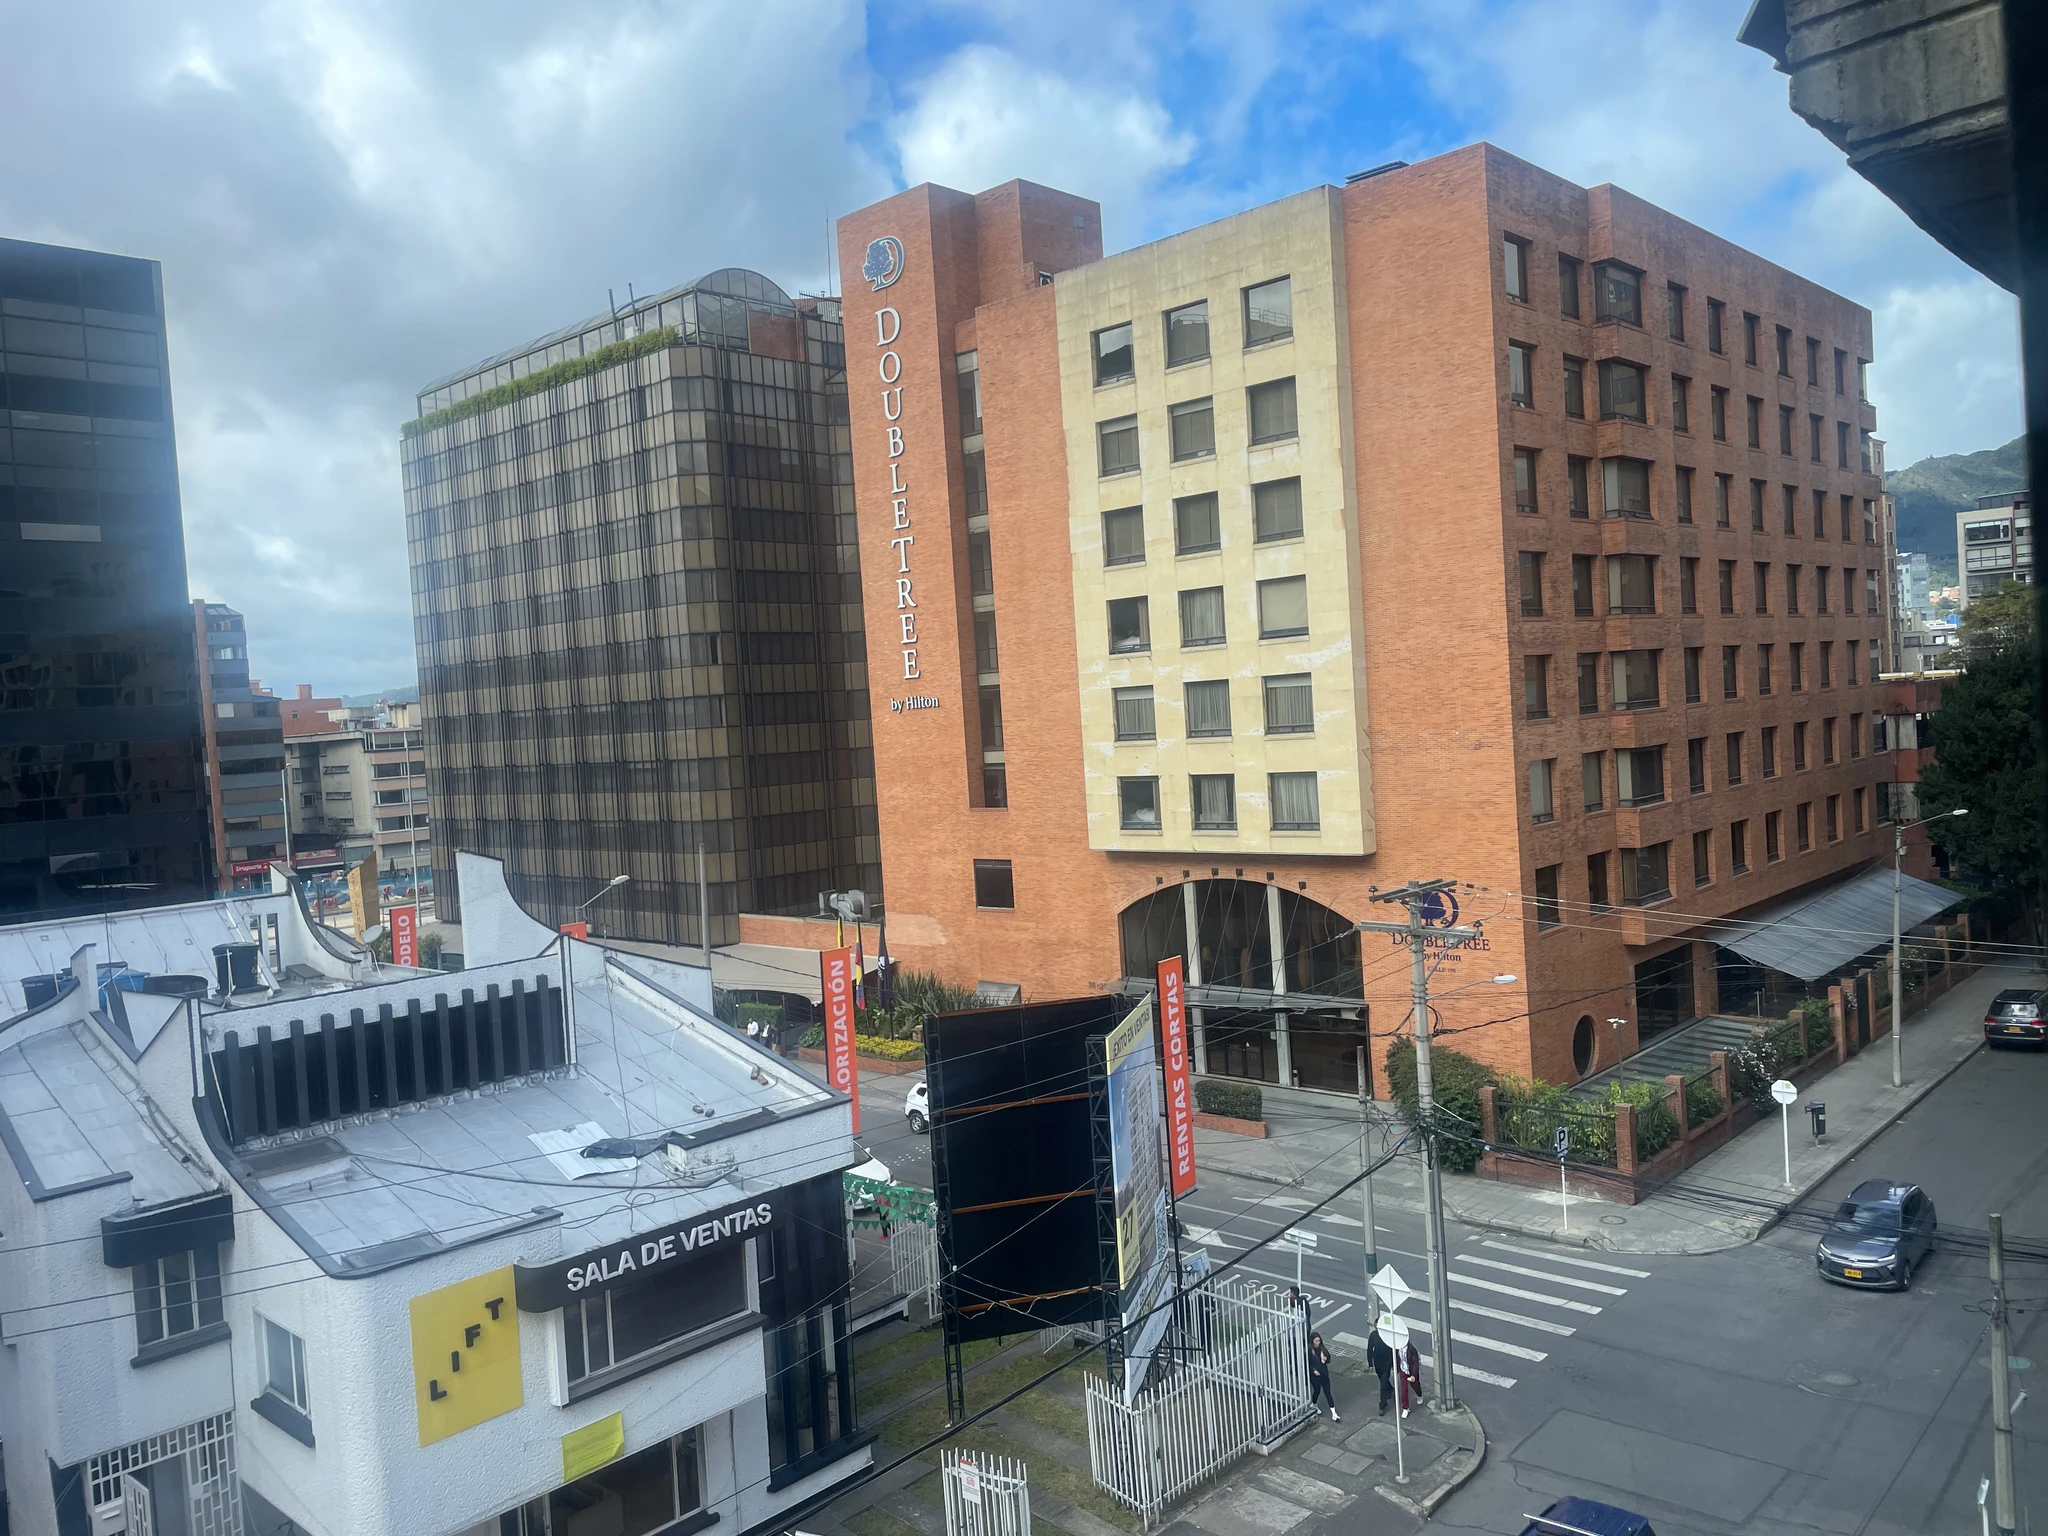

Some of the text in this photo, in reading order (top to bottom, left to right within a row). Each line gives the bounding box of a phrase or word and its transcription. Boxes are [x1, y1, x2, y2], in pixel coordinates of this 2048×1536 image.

[875, 307, 920, 680] DOUBLETREE
[890, 694, 939, 714] by Hilton
[1166, 971, 1190, 1177] RENTAS CORTAS
[1558, 1129, 1566, 1150] P
[566, 1203, 772, 1292] SALA DE VENTAS
[1122, 1206, 1134, 1250] 27
[429, 1296, 504, 1402] LIFT
